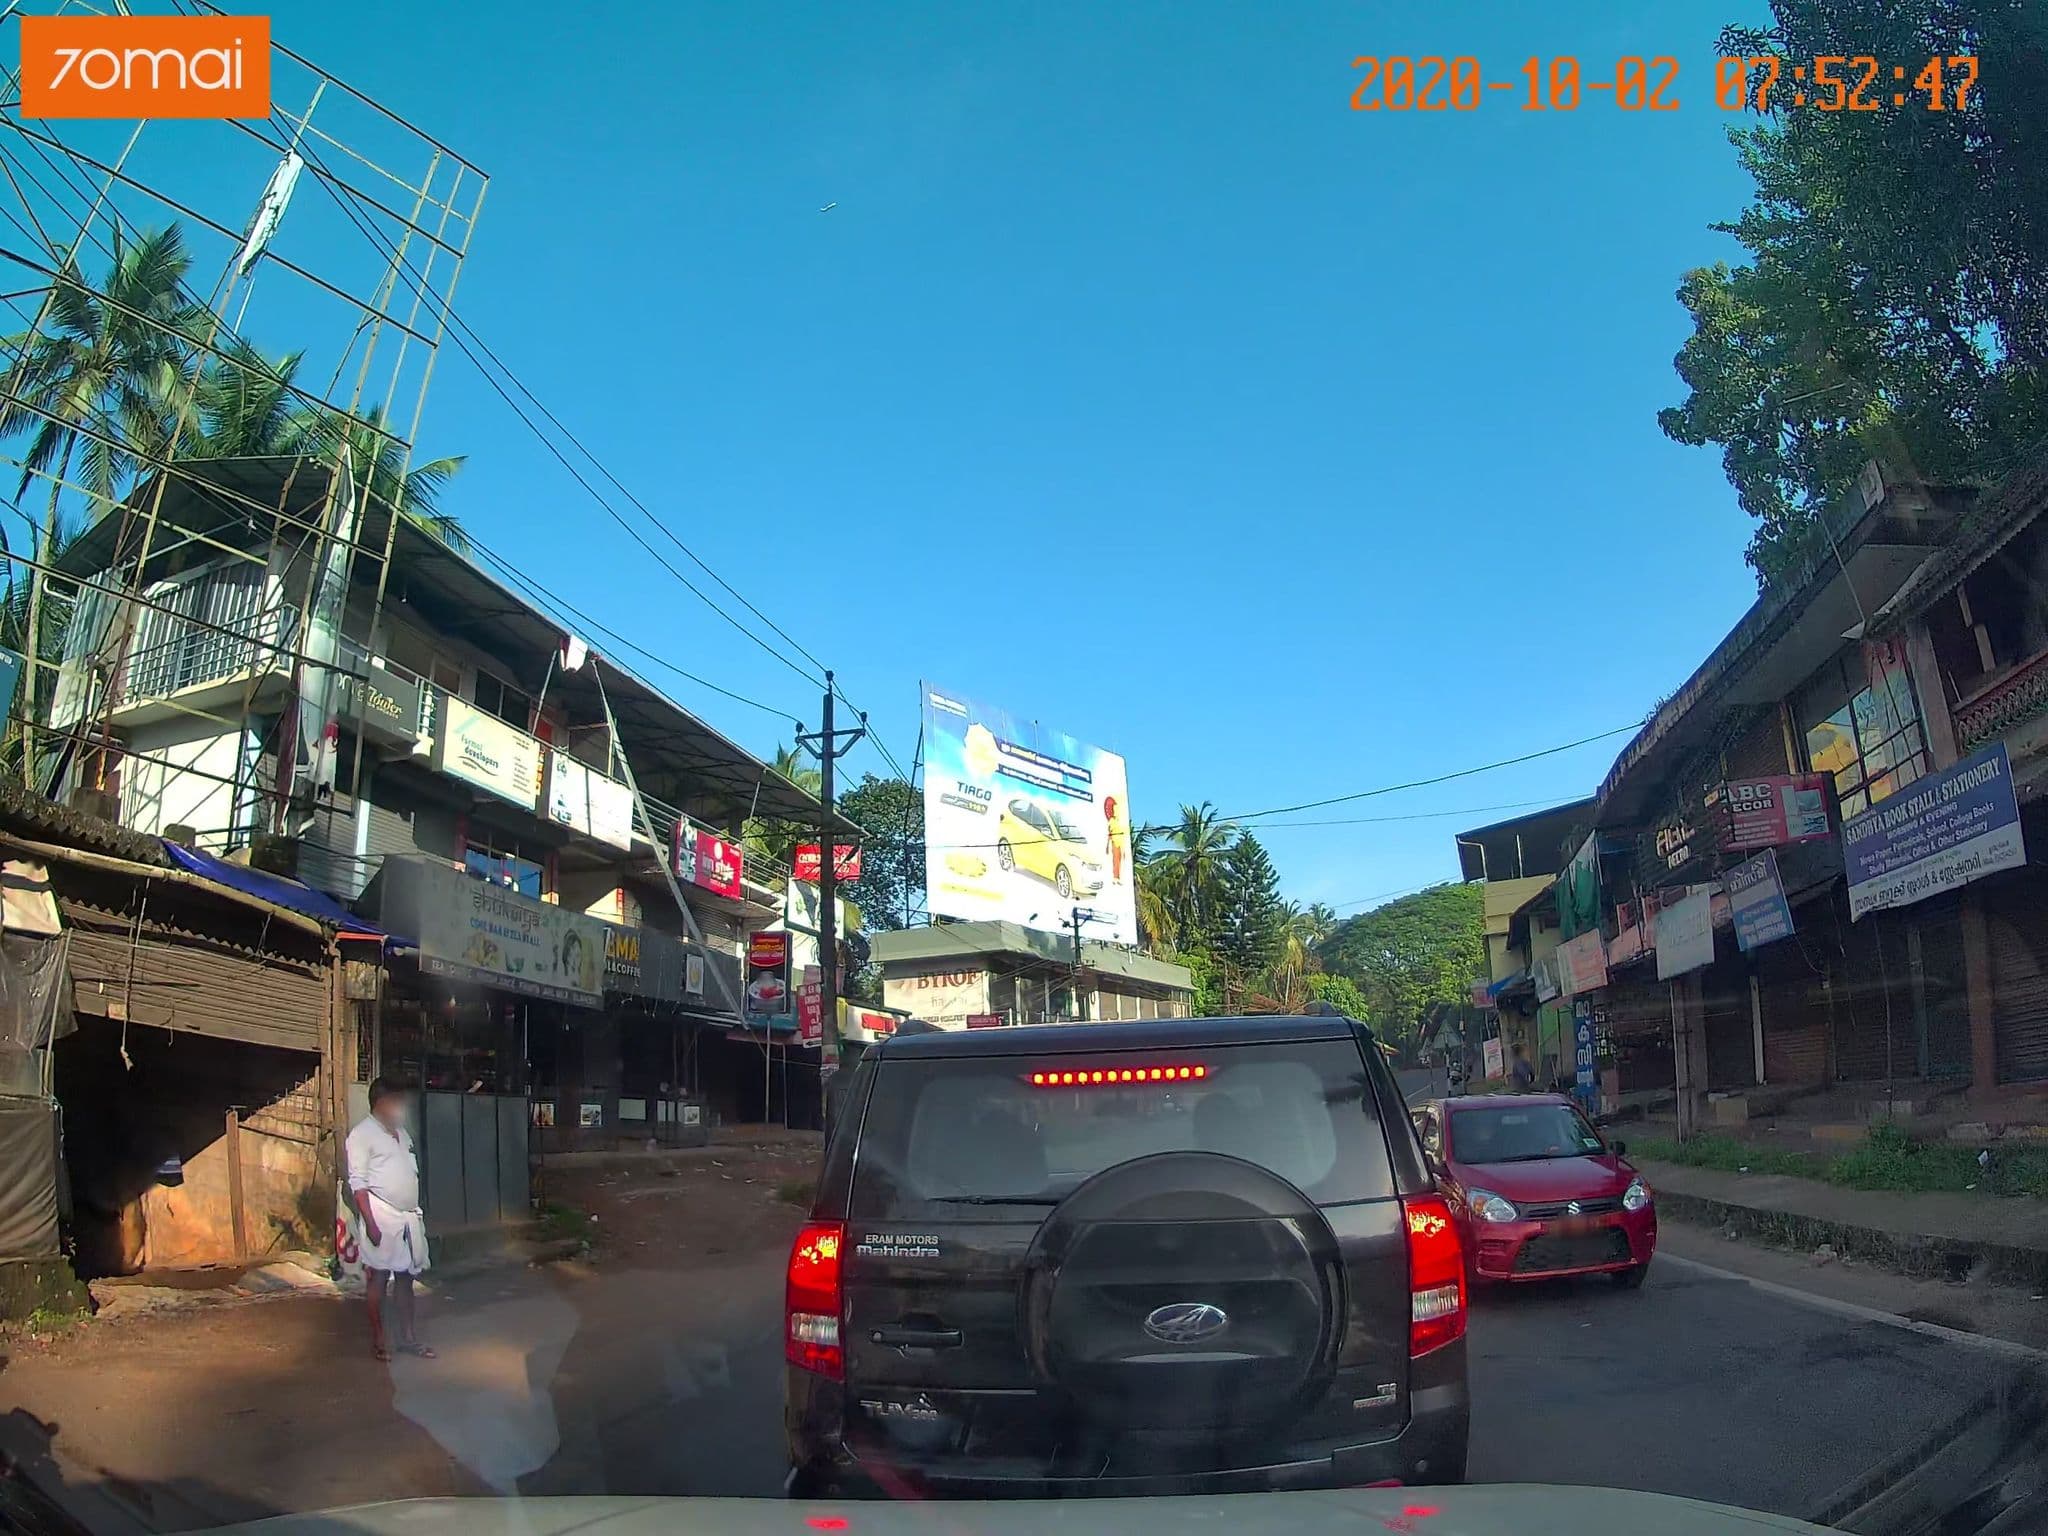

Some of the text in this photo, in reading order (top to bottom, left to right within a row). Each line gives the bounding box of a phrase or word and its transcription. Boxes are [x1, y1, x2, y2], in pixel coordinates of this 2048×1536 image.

[957, 780, 992, 801] TIAGO
[1719, 783, 1772, 803] ABC
[1845, 813, 1884, 845] SANDHYA
[1883, 801, 1908, 828] BOOK
[1907, 787, 1935, 817] STALL
[1941, 756, 2001, 801] STATIONERY
[865, 1235, 939, 1245] ERAM MOTORS
[856, 1244, 940, 1257] Mahindra
